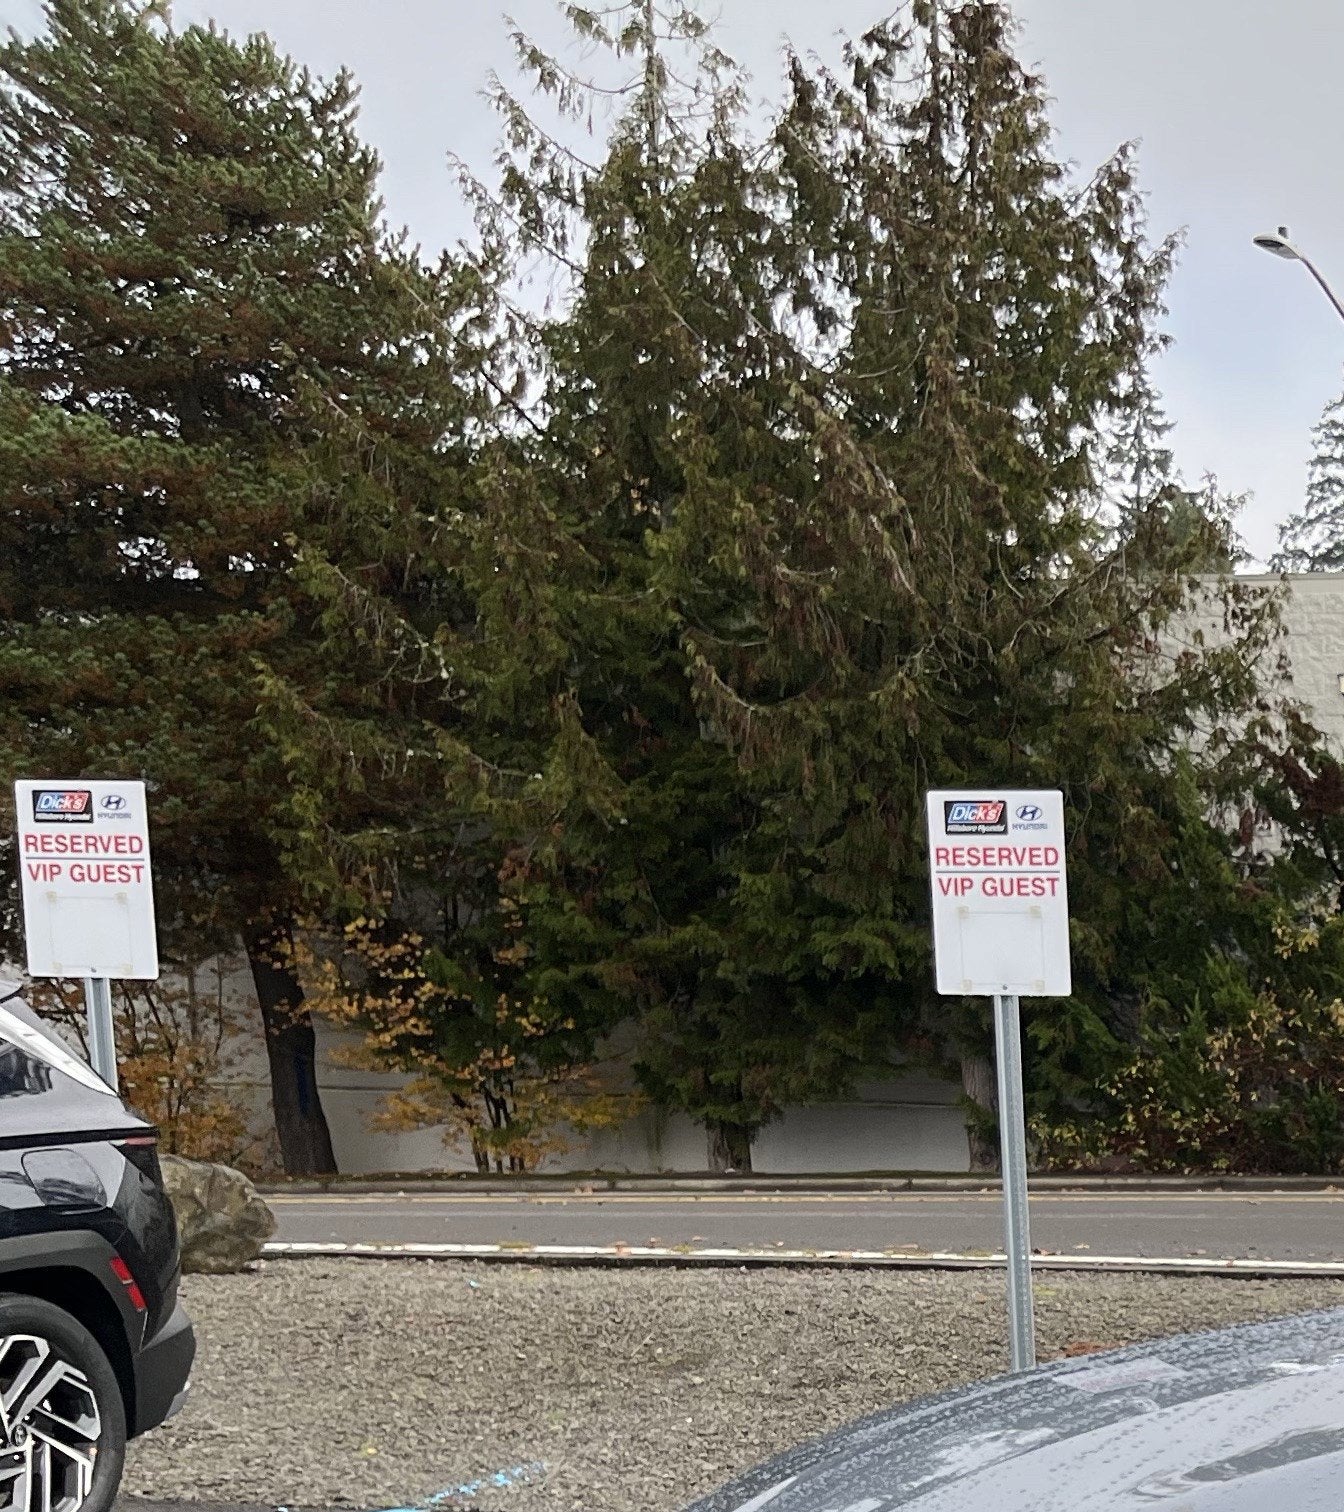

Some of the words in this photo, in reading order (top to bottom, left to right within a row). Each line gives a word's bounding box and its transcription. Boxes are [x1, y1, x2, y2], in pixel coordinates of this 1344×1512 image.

[41, 793, 83, 809] Dick's
[953, 804, 998, 821] Dick's
[24, 834, 144, 854] RESERVED
[935, 846, 1060, 867] RESERVED
[27, 863, 62, 882] VIP
[69, 863, 145, 884] GUEST
[938, 877, 974, 897] VIP
[981, 876, 1060, 897] GUEST
